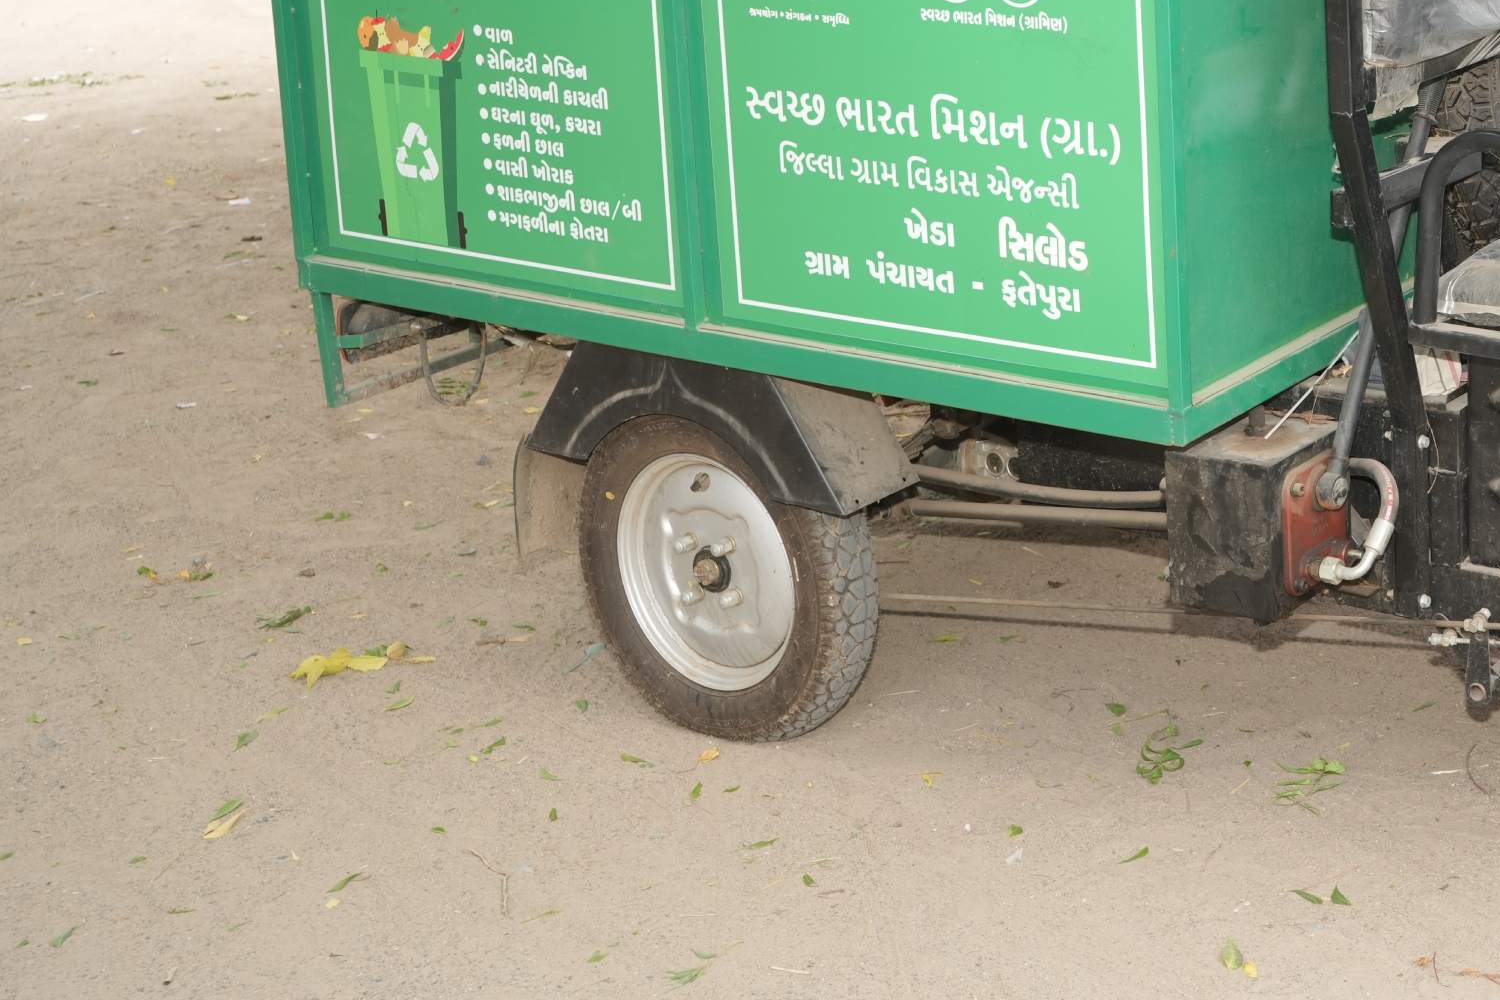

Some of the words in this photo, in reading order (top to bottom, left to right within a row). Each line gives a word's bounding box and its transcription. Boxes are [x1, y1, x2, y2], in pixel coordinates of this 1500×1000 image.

[920, 7, 951, 23] સ્વચ્છ
[952, 10, 983, 25] ભારત
[984, 7, 1016, 28] મિશન
[484, 27, 513, 45] વાળ
[563, 87, 609, 110] કાચલી
[565, 116, 602, 136] કચરા
[746, 86, 826, 126] સ્વચ્છ
[835, 96, 920, 138] ભારત
[930, 93, 1028, 149] મિશન
[534, 138, 564, 158] છાલ
[494, 156, 529, 179] વાસી
[531, 159, 574, 185] ખોરાક
[779, 140, 844, 181] જિલ્લા
[850, 157, 900, 188] ગ્રામ
[906, 155, 980, 198] વિકાસ
[986, 165, 1080, 210] એજન્સી
[903, 207, 955, 248] ખેડા
[804, 250, 850, 279] ગ્રામ
[865, 250, 955, 294] પંચાયત
